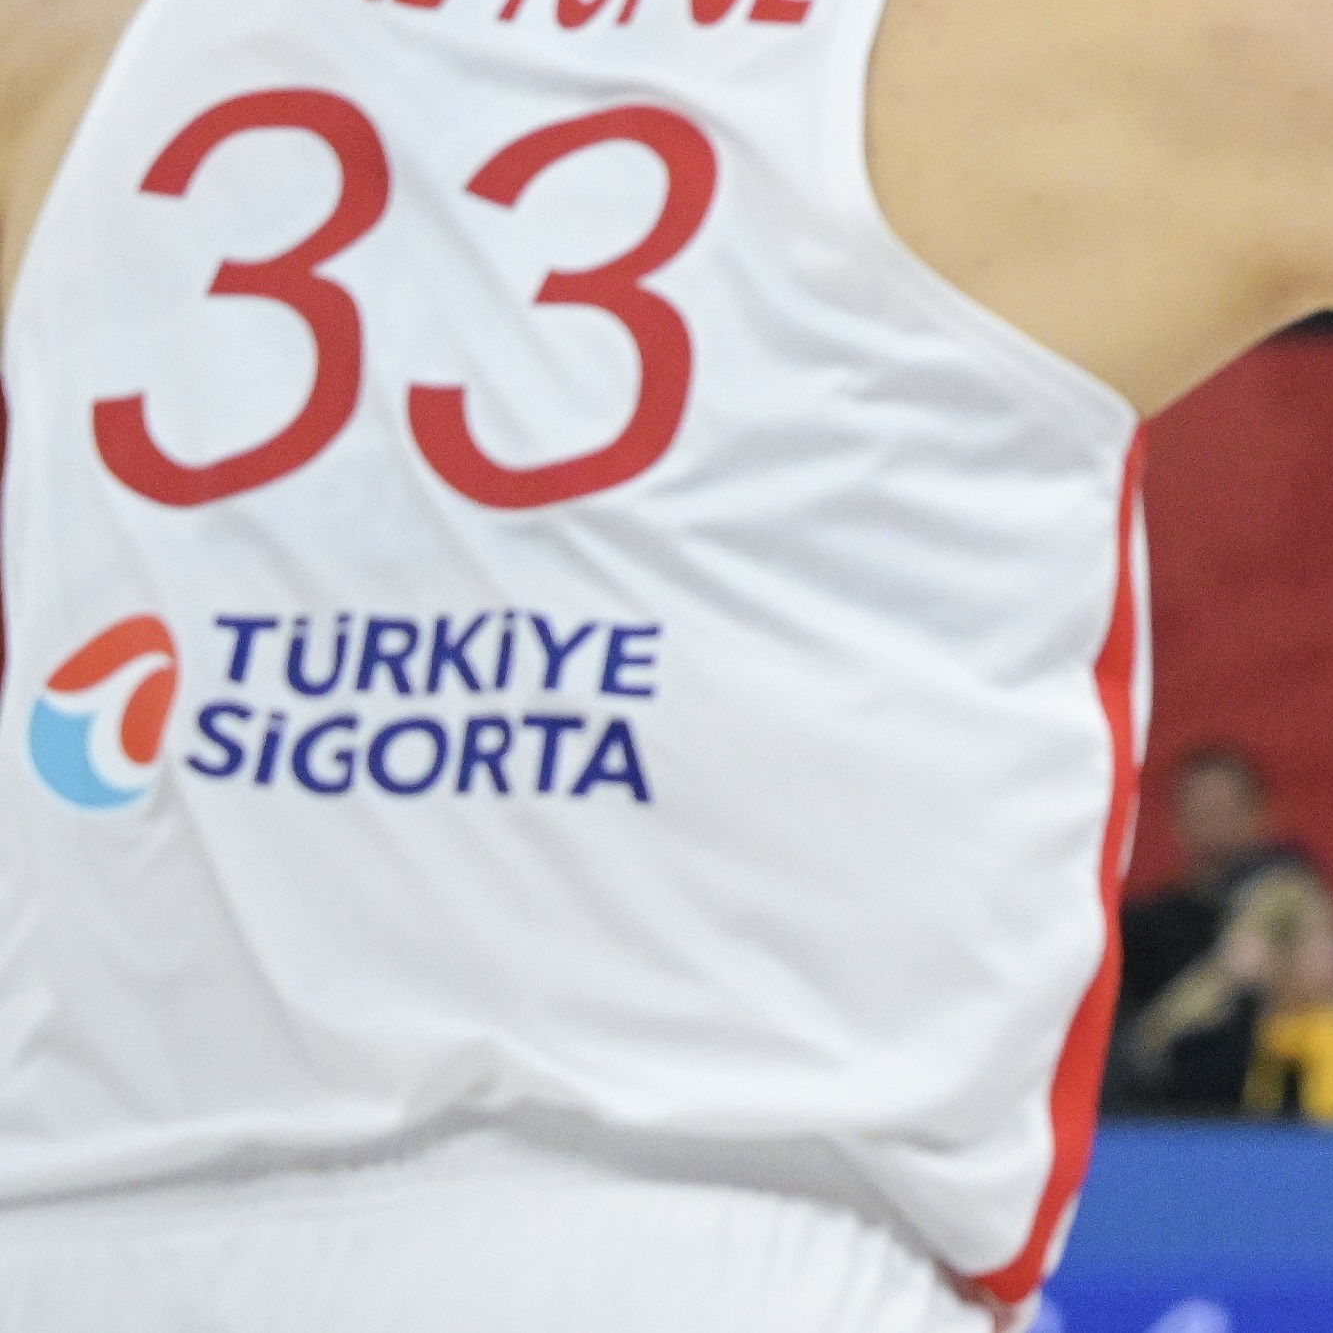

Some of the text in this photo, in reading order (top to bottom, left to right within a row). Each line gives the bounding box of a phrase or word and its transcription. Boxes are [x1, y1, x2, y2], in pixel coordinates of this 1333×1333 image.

[93, 89, 718, 509] 33
[215, 610, 665, 701] TÜRKİYE
[189, 699, 653, 804] SİGORTA
